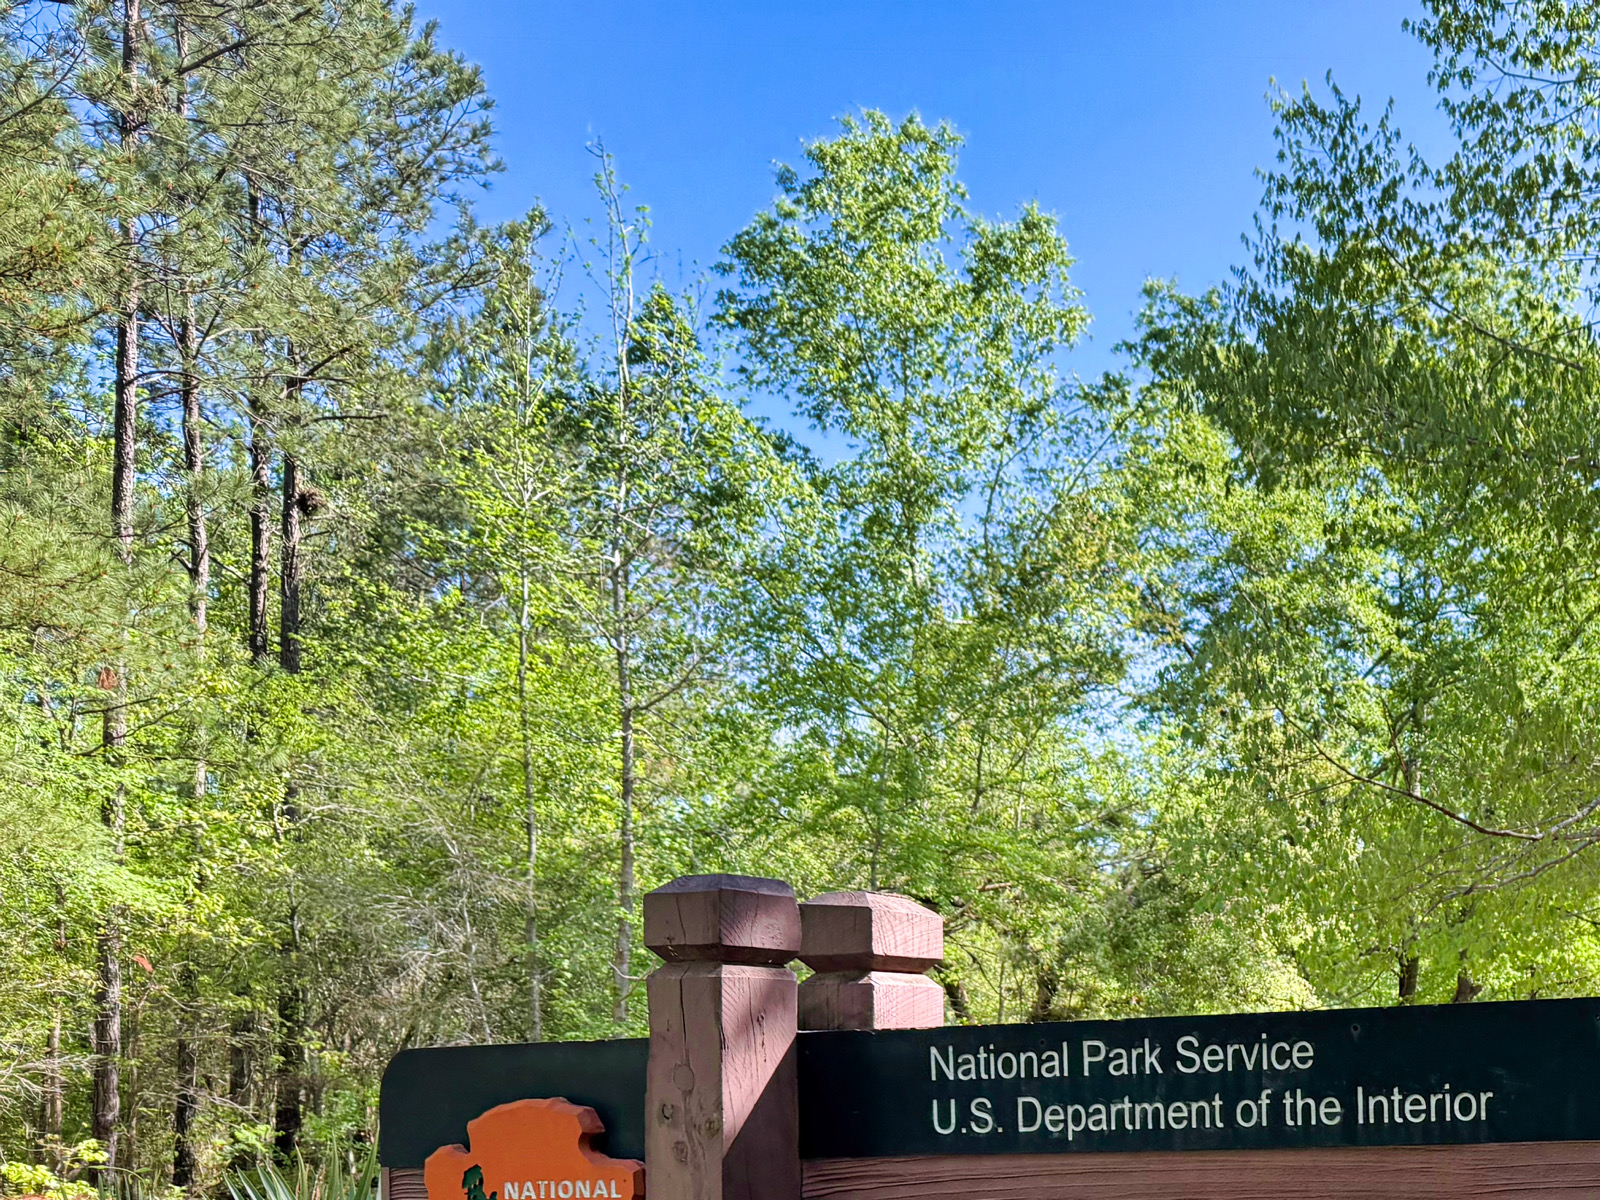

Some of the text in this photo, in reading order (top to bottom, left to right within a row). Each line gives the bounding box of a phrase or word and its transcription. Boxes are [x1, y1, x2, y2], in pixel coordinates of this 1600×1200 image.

[930, 1033, 1314, 1082] National Park Service
[931, 1082, 1493, 1141] U.S. Department of the Interior
[504, 1179, 622, 1200] NATIONAL
